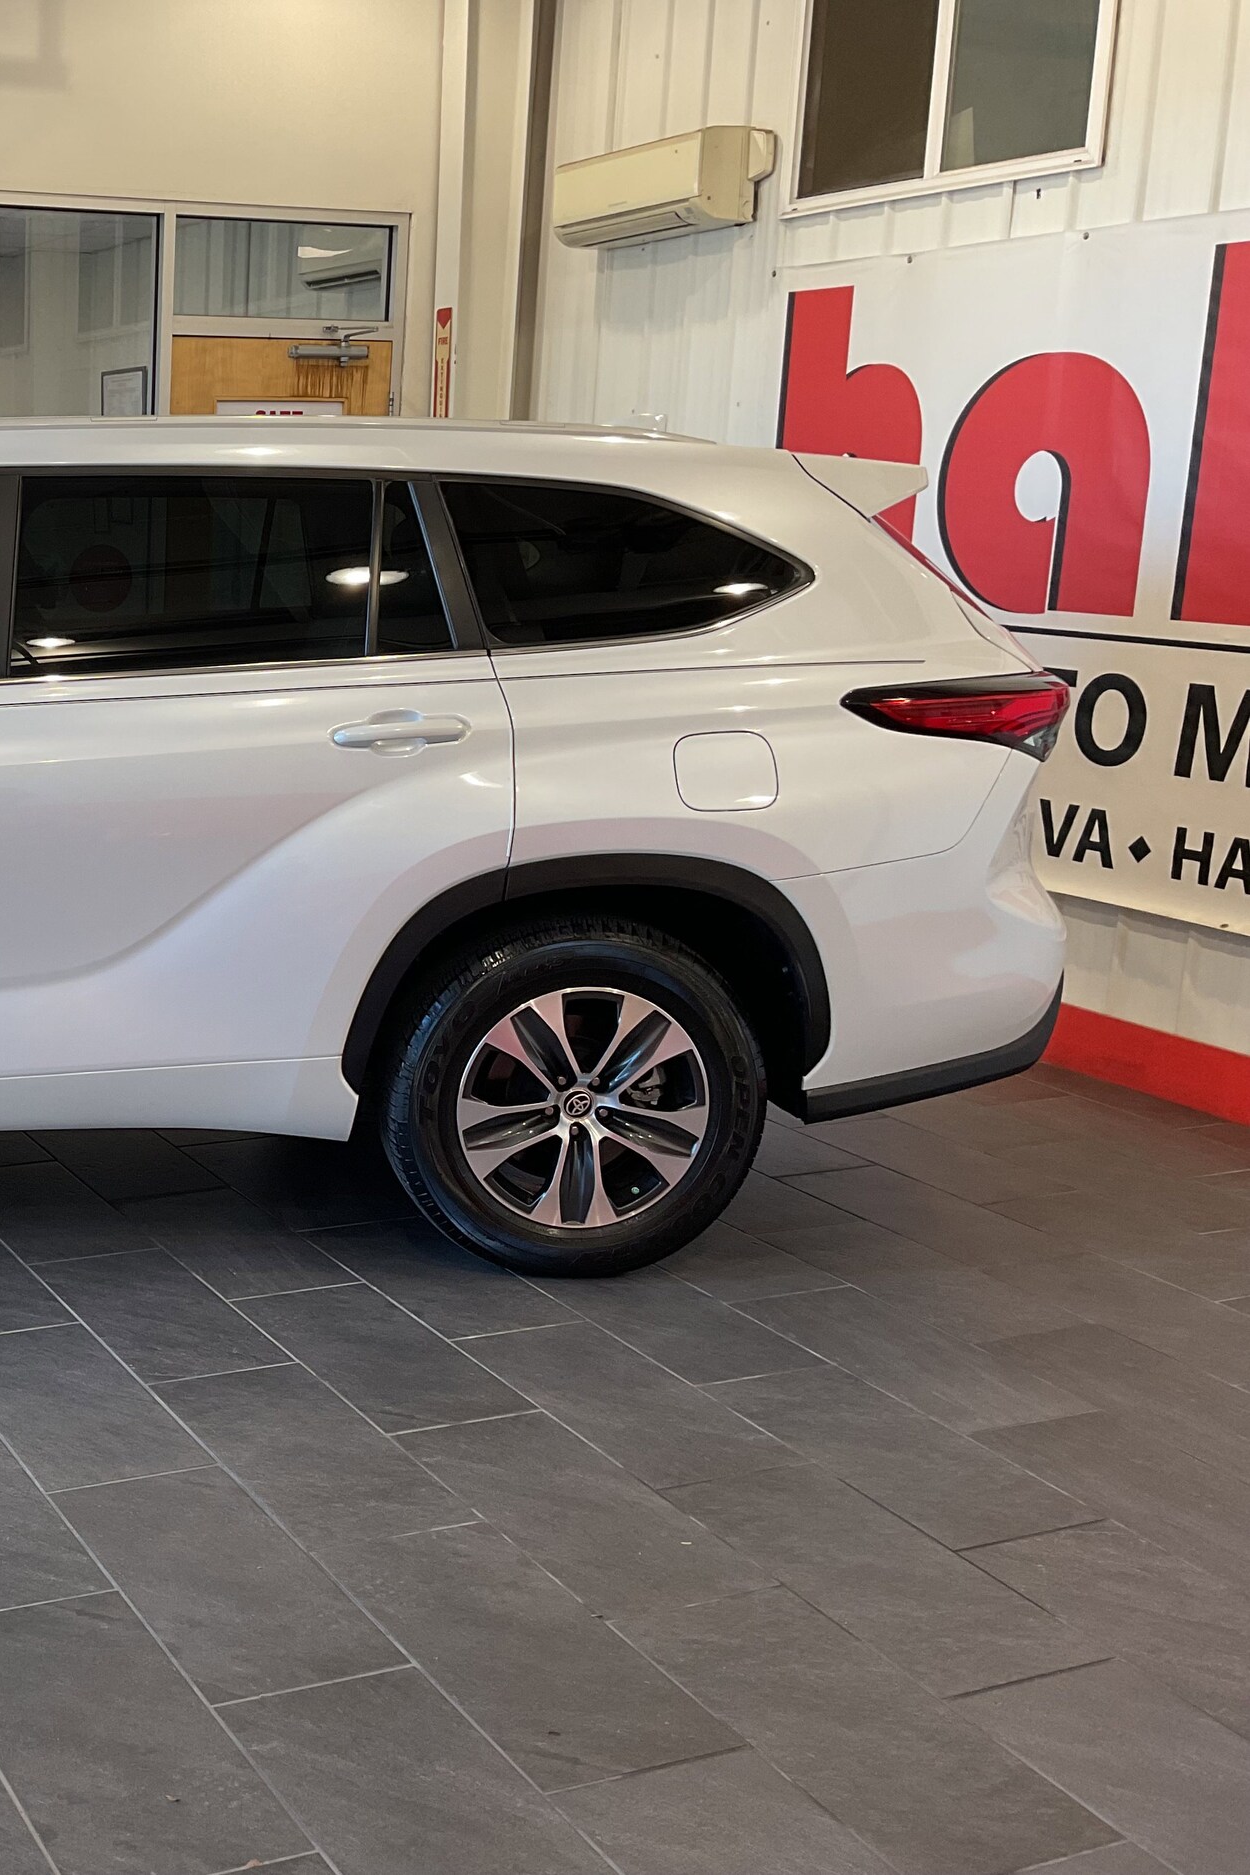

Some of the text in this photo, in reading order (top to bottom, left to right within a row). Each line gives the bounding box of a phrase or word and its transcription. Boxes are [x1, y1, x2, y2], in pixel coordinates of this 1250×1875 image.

[438, 337, 449, 345] FIRE
[1039, 799, 1114, 869] VA
[419, 1003, 476, 1121] TOYO
[726, 1055, 758, 1163] OPEN
